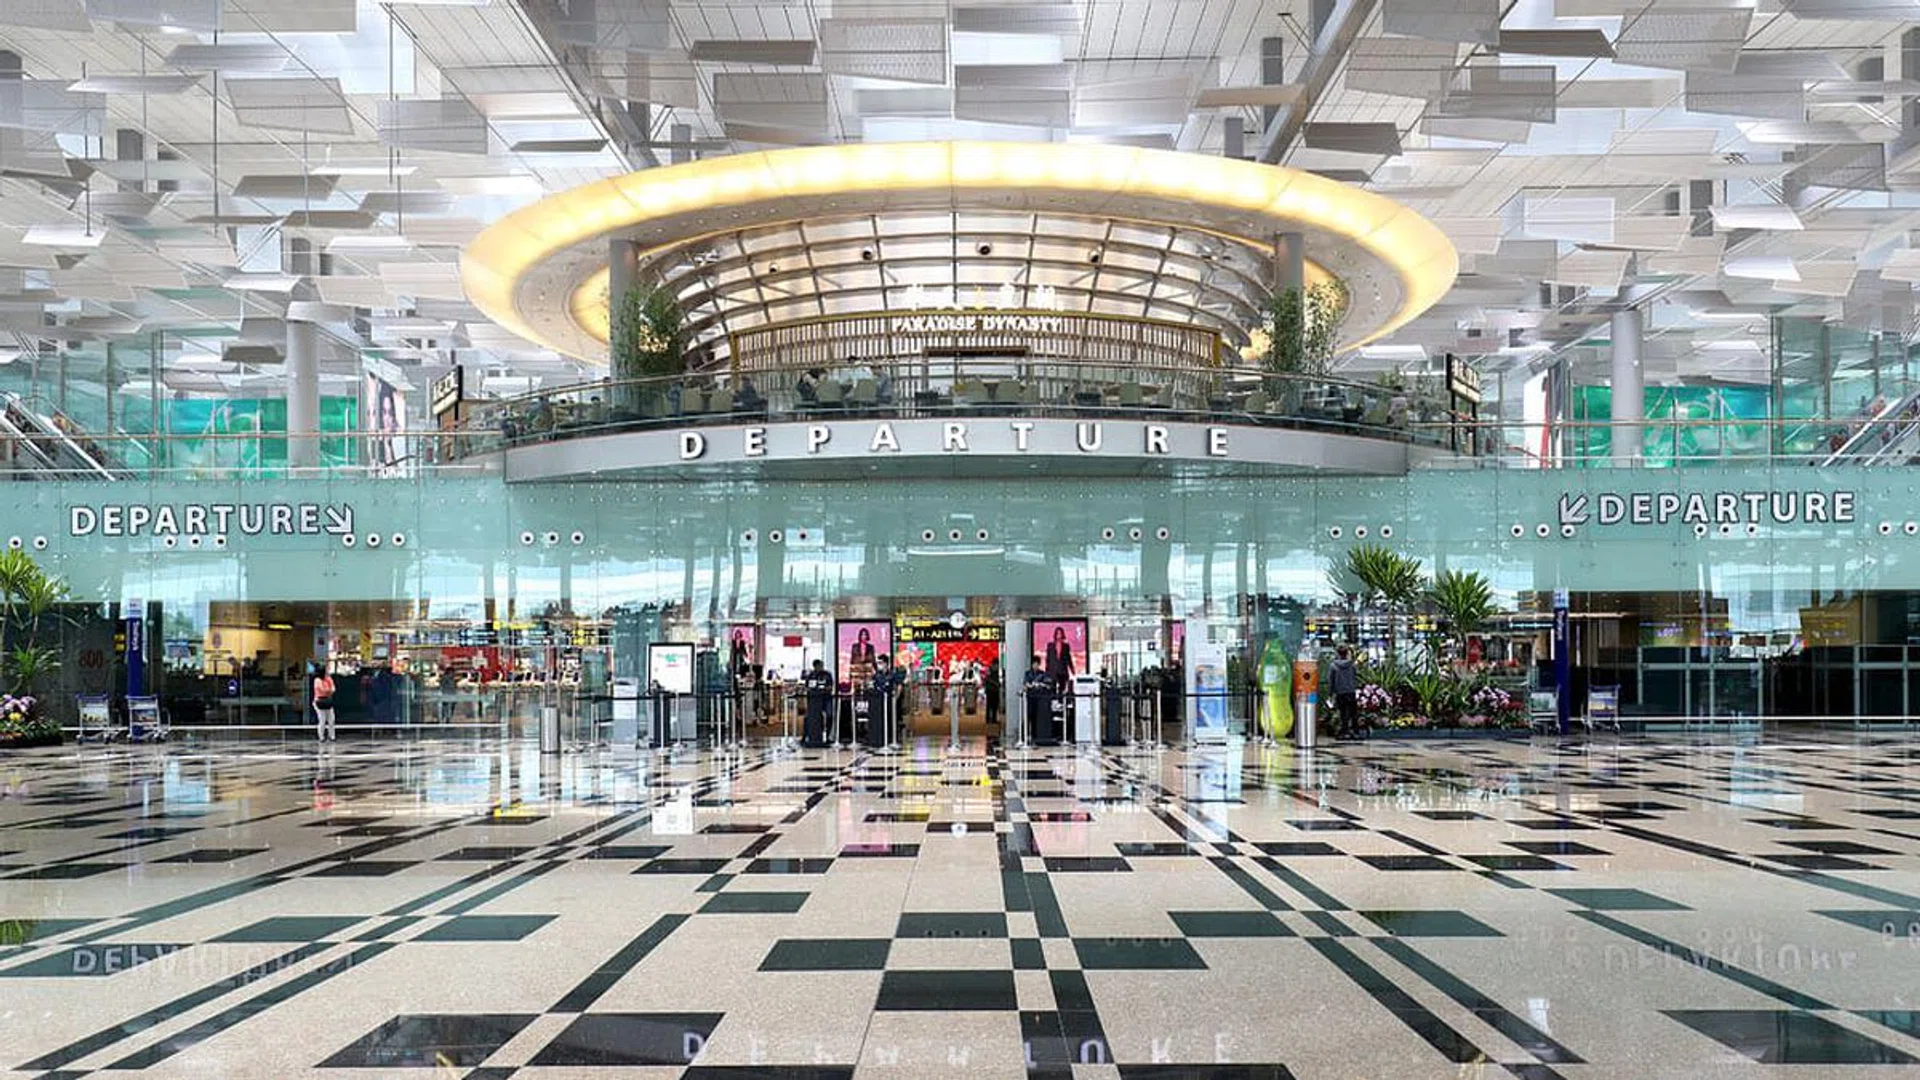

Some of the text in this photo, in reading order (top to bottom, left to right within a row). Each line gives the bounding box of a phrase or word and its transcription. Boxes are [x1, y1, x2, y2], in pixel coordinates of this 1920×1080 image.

[891, 315, 1062, 331] PARADISE DYNASTY
[679, 421, 1231, 460] DEPARTURE
[70, 503, 320, 536] DEPARTURE
[1598, 492, 1855, 525] DEPARTURE
